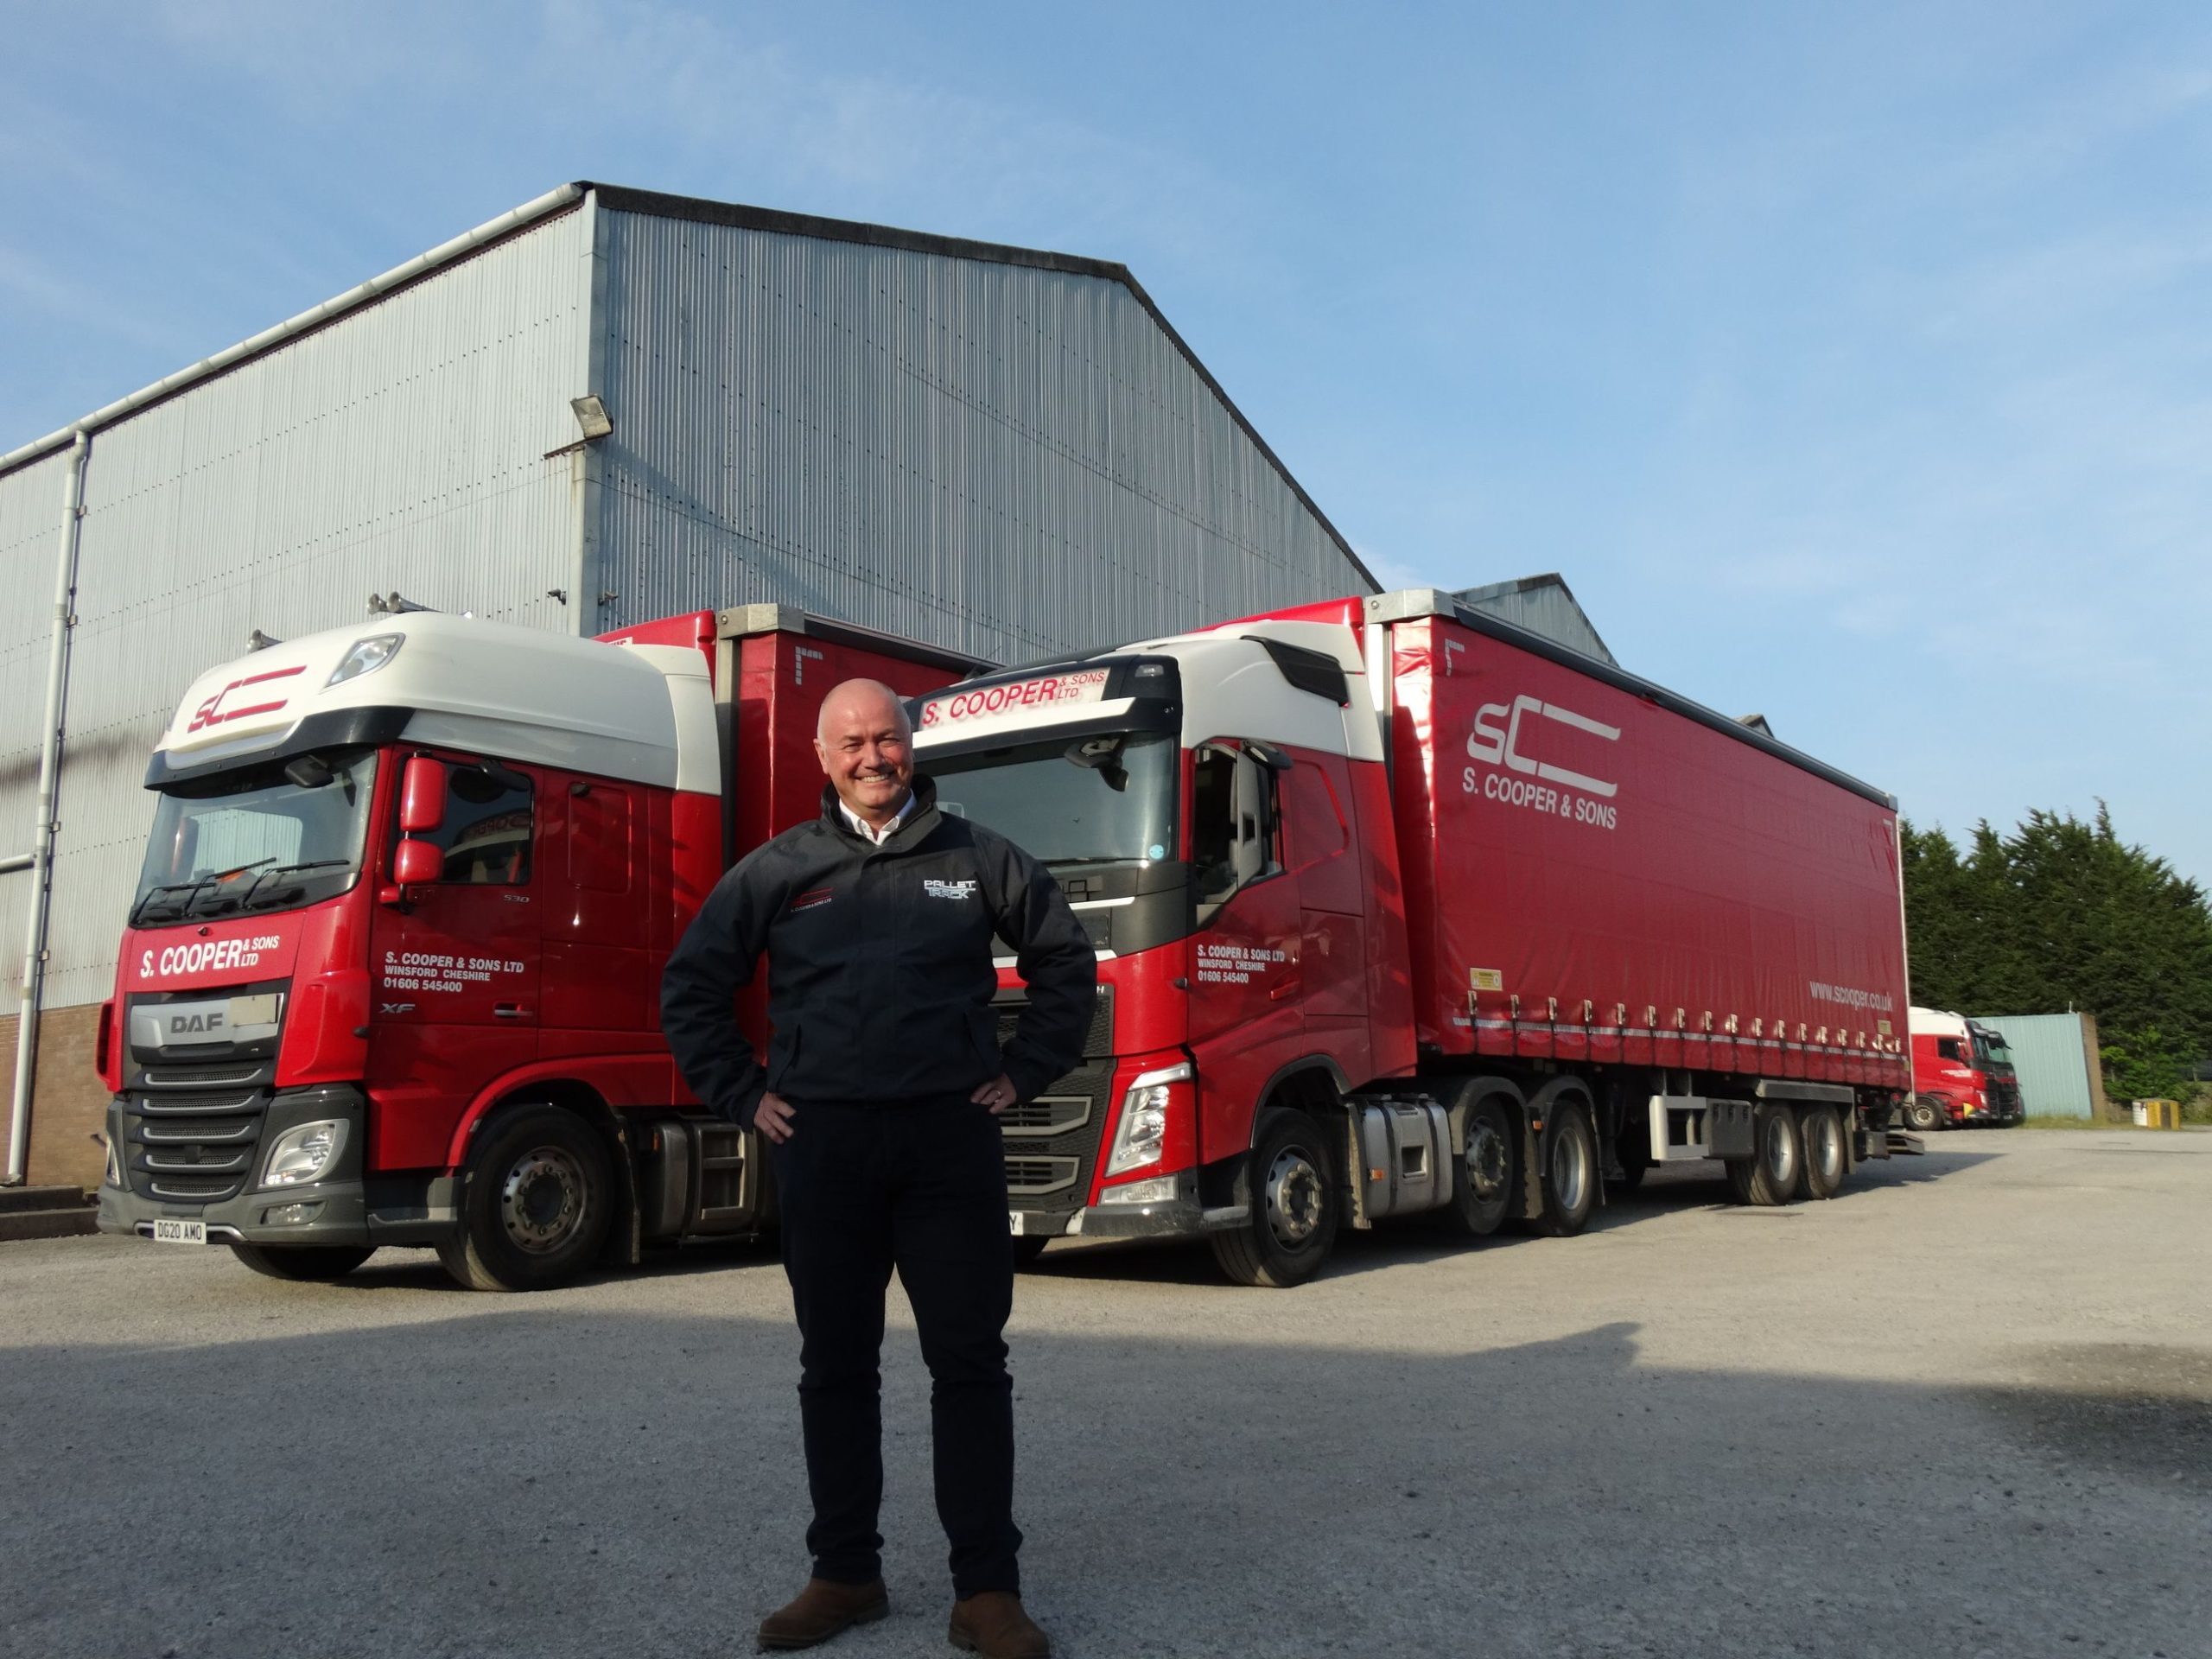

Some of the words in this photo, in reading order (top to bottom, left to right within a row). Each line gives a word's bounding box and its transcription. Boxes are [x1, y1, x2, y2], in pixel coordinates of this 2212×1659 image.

[923, 702, 939, 725] S.
[950, 678, 1058, 718] COOPER
[1059, 677, 1067, 686] &
[1071, 671, 1105, 685] SONS
[1057, 687, 1078, 700] LTD
[1463, 766, 1478, 794] S.
[1484, 773, 1557, 814] COOPER
[1560, 794, 1572, 818] &
[1575, 798, 1617, 830] SONS
[925, 880, 976, 888] PALLET
[927, 888, 969, 899] TRACK
[140, 950, 154, 977] S.
[160, 939, 243, 976] COOPER
[243, 938, 250, 950] &
[251, 935, 280, 950] SONS
[241, 953, 258, 967] LTD
[1198, 944, 1206, 957] S.
[1208, 945, 1242, 958] COOPER
[1243, 948, 1249, 959] &
[1250, 949, 1271, 962] SONS
[1272, 950, 1285, 962] LTD
[385, 951, 397, 963] S.
[402, 953, 454, 968] COOPER
[456, 957, 465, 969] &
[468, 958, 501, 971] SONS
[504, 961, 524, 973] LTD
[1198, 958, 1233, 969] WINSFORD
[1236, 960, 1265, 971] CHESHIRE
[385, 965, 438, 977] WINSFORD
[442, 969, 491, 982] CHESHIRE
[1198, 970, 1221, 982] 01606
[1223, 971, 1249, 983] 545400
[384, 977, 419, 990] 01606
[422, 980, 462, 992] 545400
[1096, 985, 1104, 994] H
[1809, 981, 1892, 1012] www.scooper.co.uk
[380, 1003, 416, 1014] XF
[171, 1013, 223, 1033] DAF
[158, 1222, 181, 1238] DG20
[184, 1224, 202, 1240] AMO
